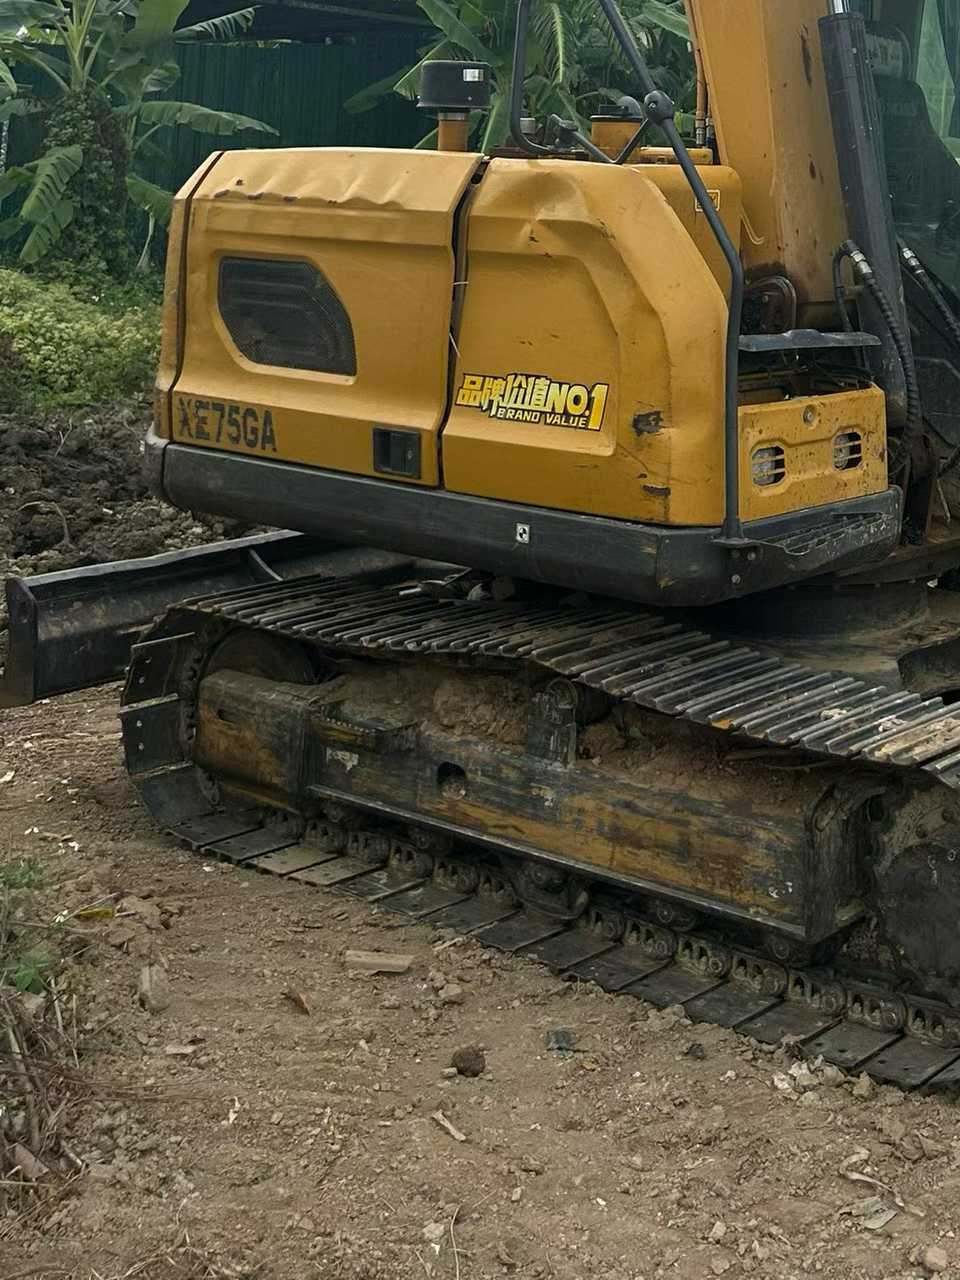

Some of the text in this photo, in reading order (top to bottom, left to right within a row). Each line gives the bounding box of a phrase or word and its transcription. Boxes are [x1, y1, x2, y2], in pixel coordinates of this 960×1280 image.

[178, 398, 278, 453] XE75GA
[496, 408, 588, 428] BRAND VALUE
